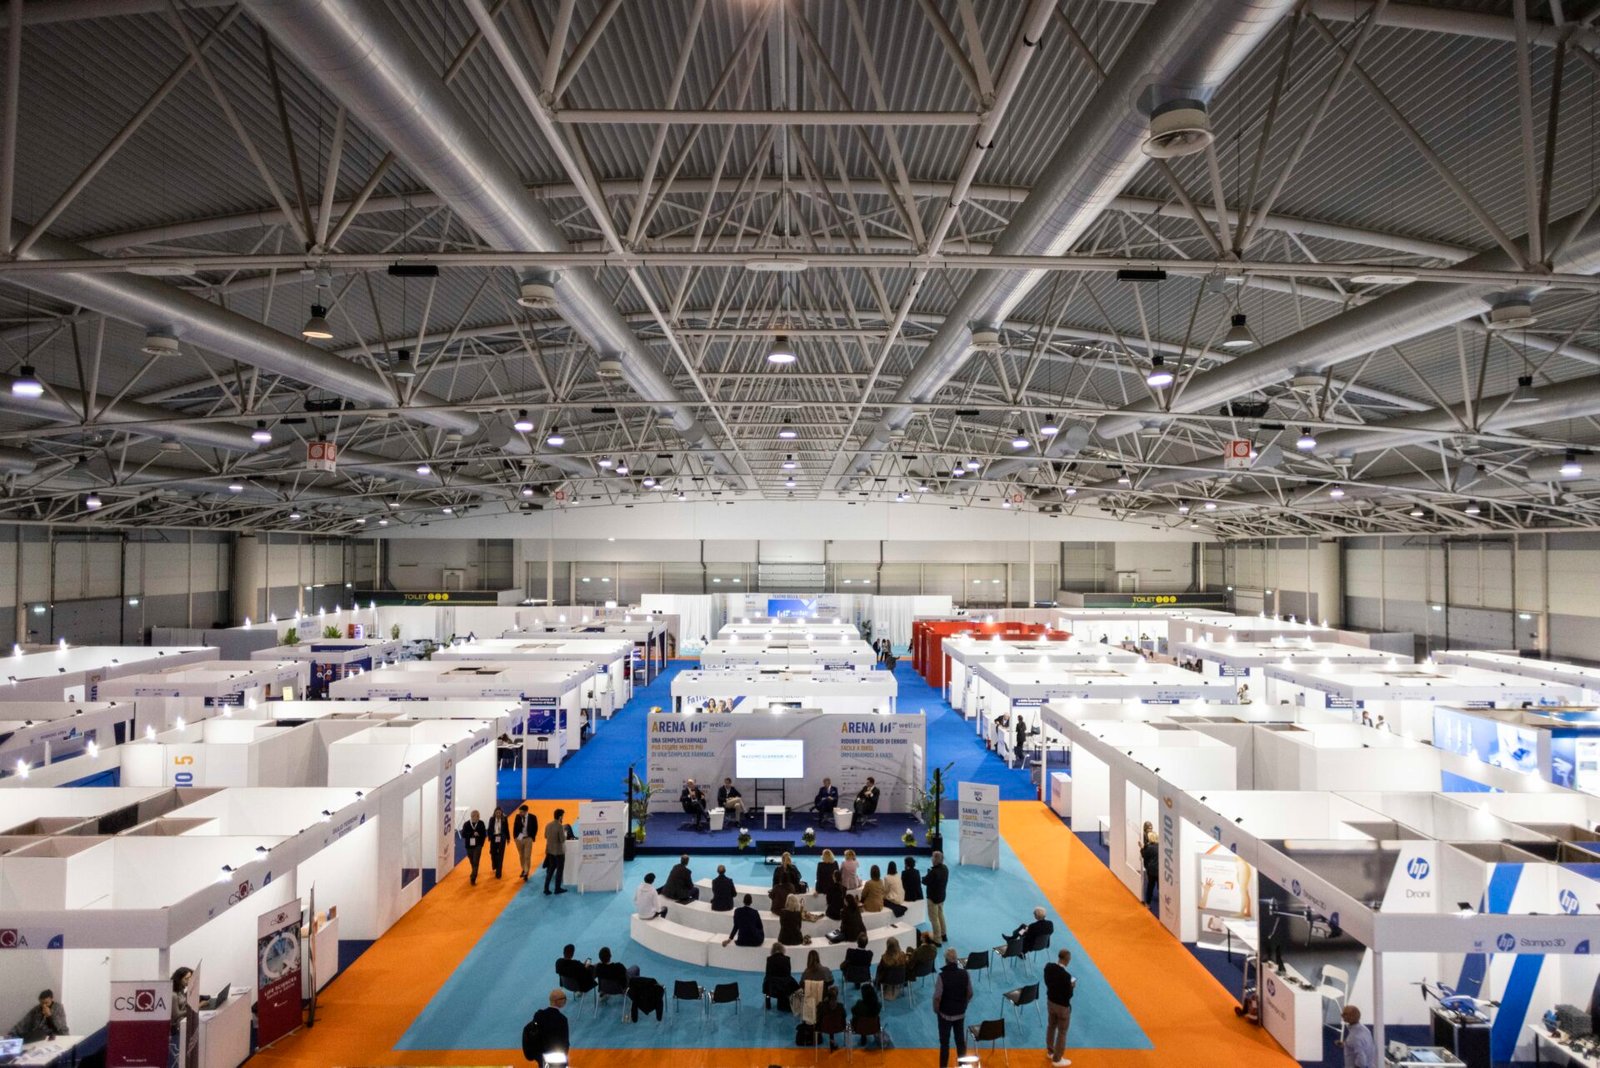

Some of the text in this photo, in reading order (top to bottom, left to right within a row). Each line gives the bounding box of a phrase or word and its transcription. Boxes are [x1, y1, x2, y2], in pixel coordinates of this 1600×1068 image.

[652, 722, 686, 732] ARENA
[842, 722, 876, 733] ARENA
[175, 756, 193, 764] 5
[445, 758, 452, 770] 5
[444, 776, 452, 836] SPAZIO
[1164, 815, 1173, 886] SPAZIO
[1408, 857, 1430, 880] hp
[1406, 889, 1430, 898] Droni
[1559, 889, 1580, 915] hp
[1497, 933, 1516, 952] hp
[114, 990, 166, 1012] CSQA
